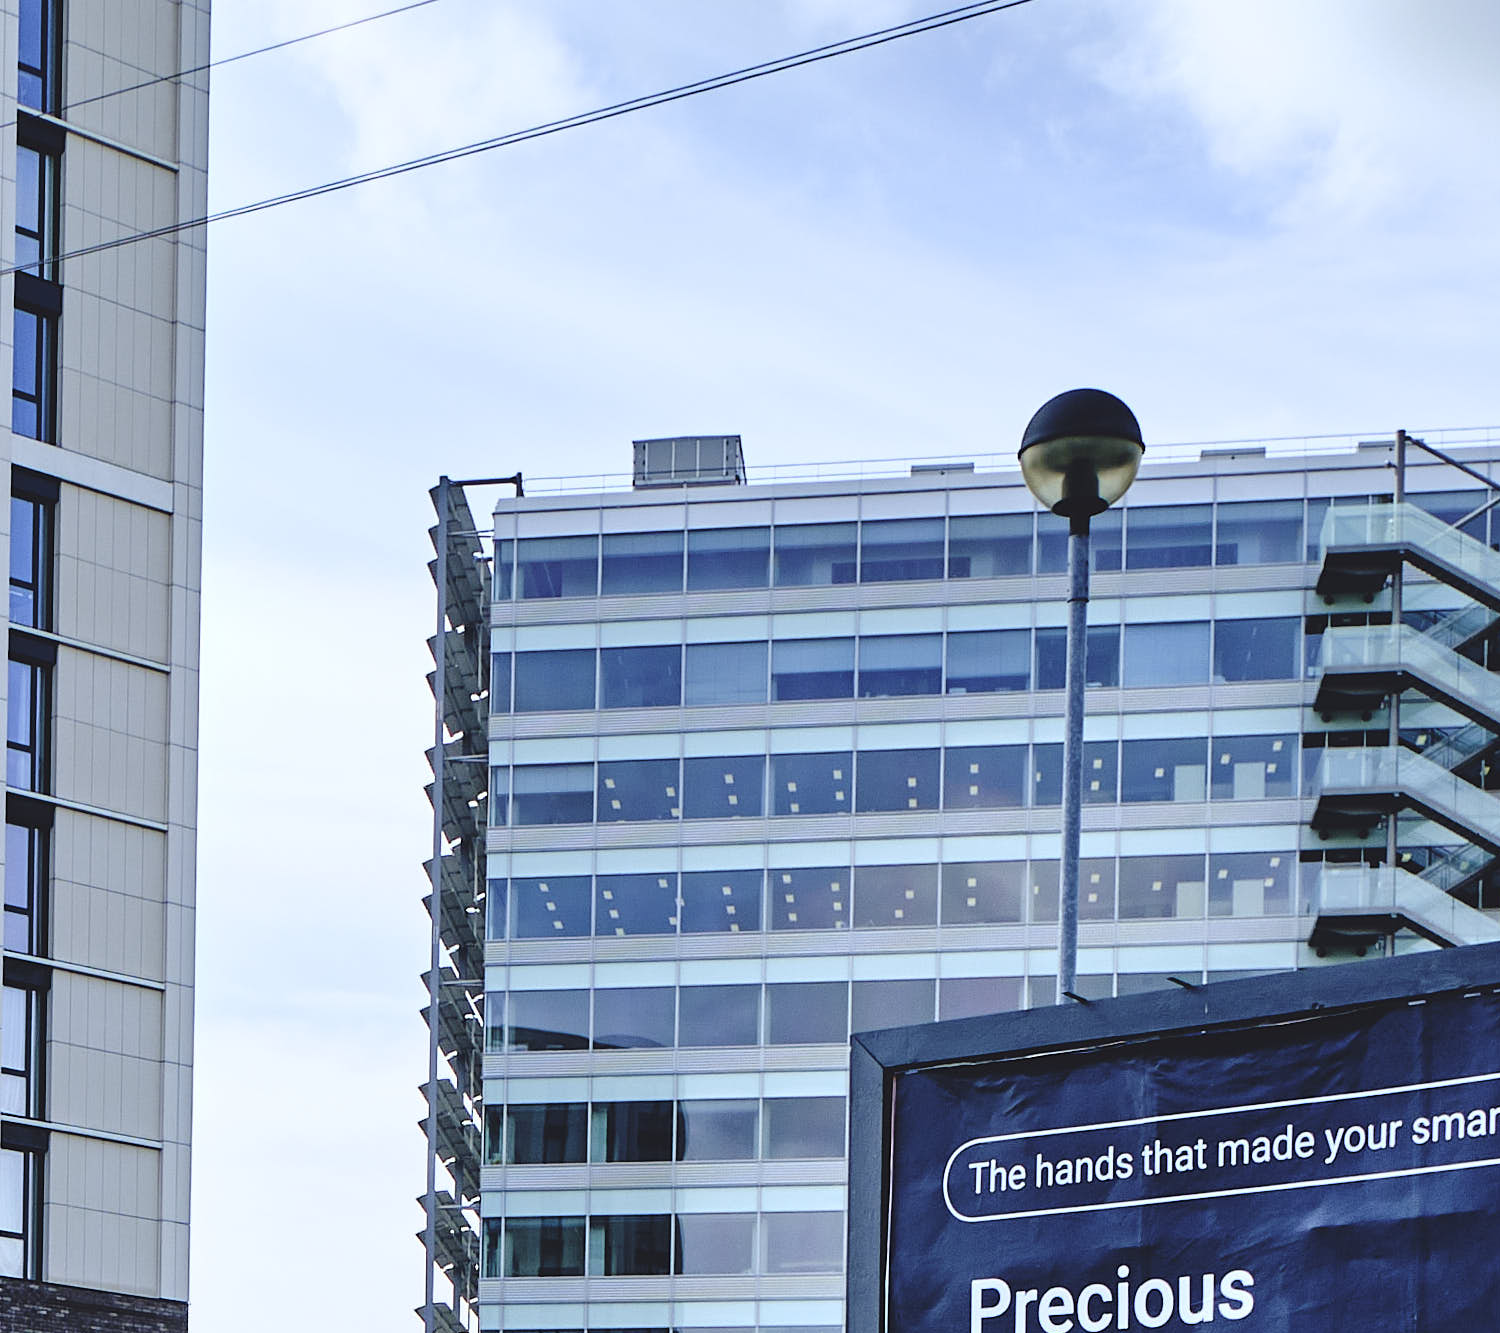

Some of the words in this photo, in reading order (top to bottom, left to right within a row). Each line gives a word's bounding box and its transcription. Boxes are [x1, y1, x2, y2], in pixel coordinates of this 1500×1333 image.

[969, 1159, 1026, 1194] The
[1035, 1146, 1133, 1188] hands
[1142, 1139, 1207, 1177] that
[1218, 1124, 1315, 1167] made
[1324, 1119, 1403, 1164] your
